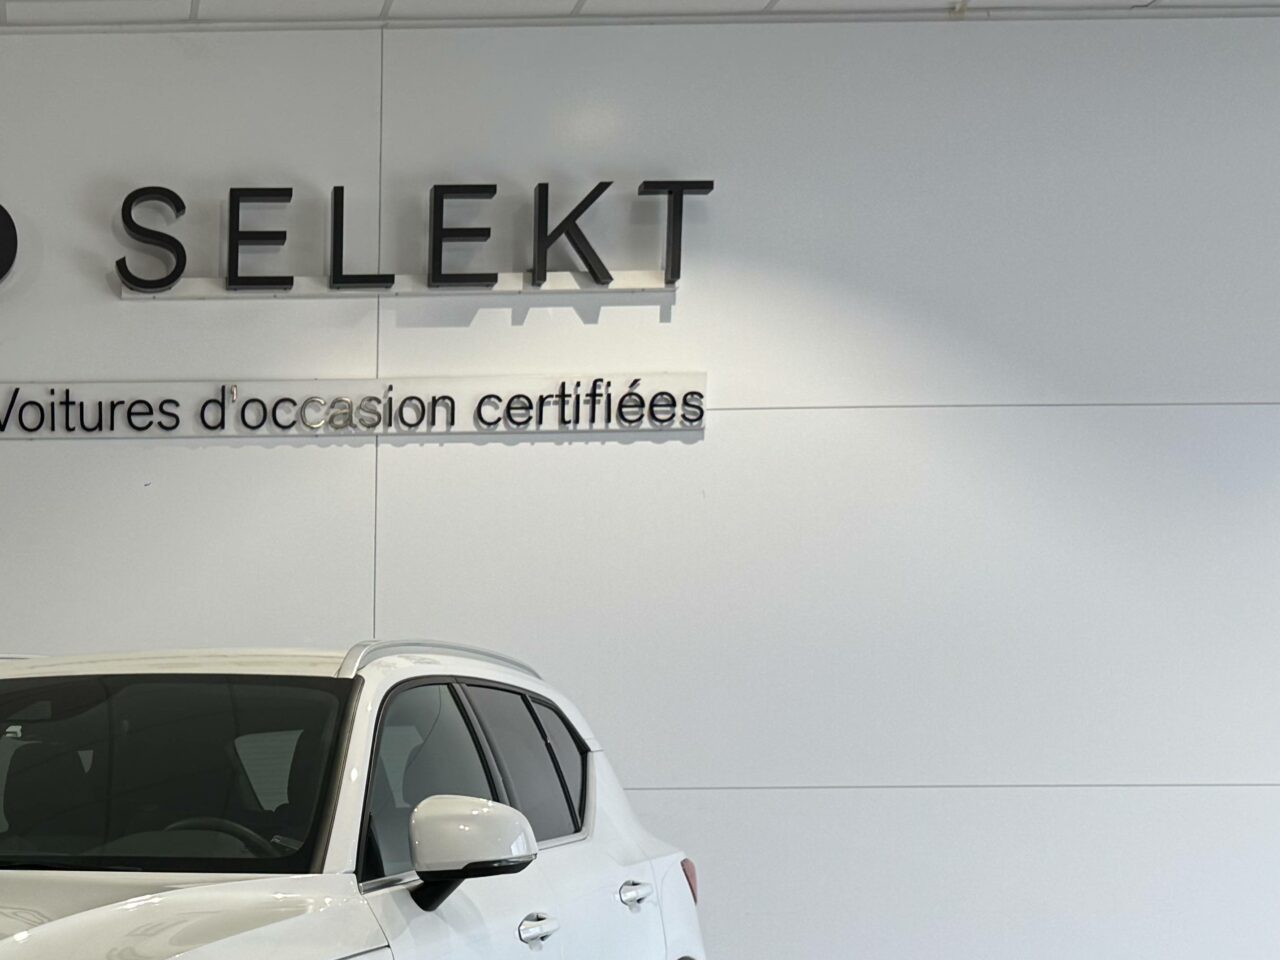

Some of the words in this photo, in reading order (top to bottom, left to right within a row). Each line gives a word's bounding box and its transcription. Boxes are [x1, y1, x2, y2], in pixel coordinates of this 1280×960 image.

[115, 180, 714, 292] SELEKT
[200, 383, 456, 431] d'occasion
[476, 378, 706, 426] certifiées
